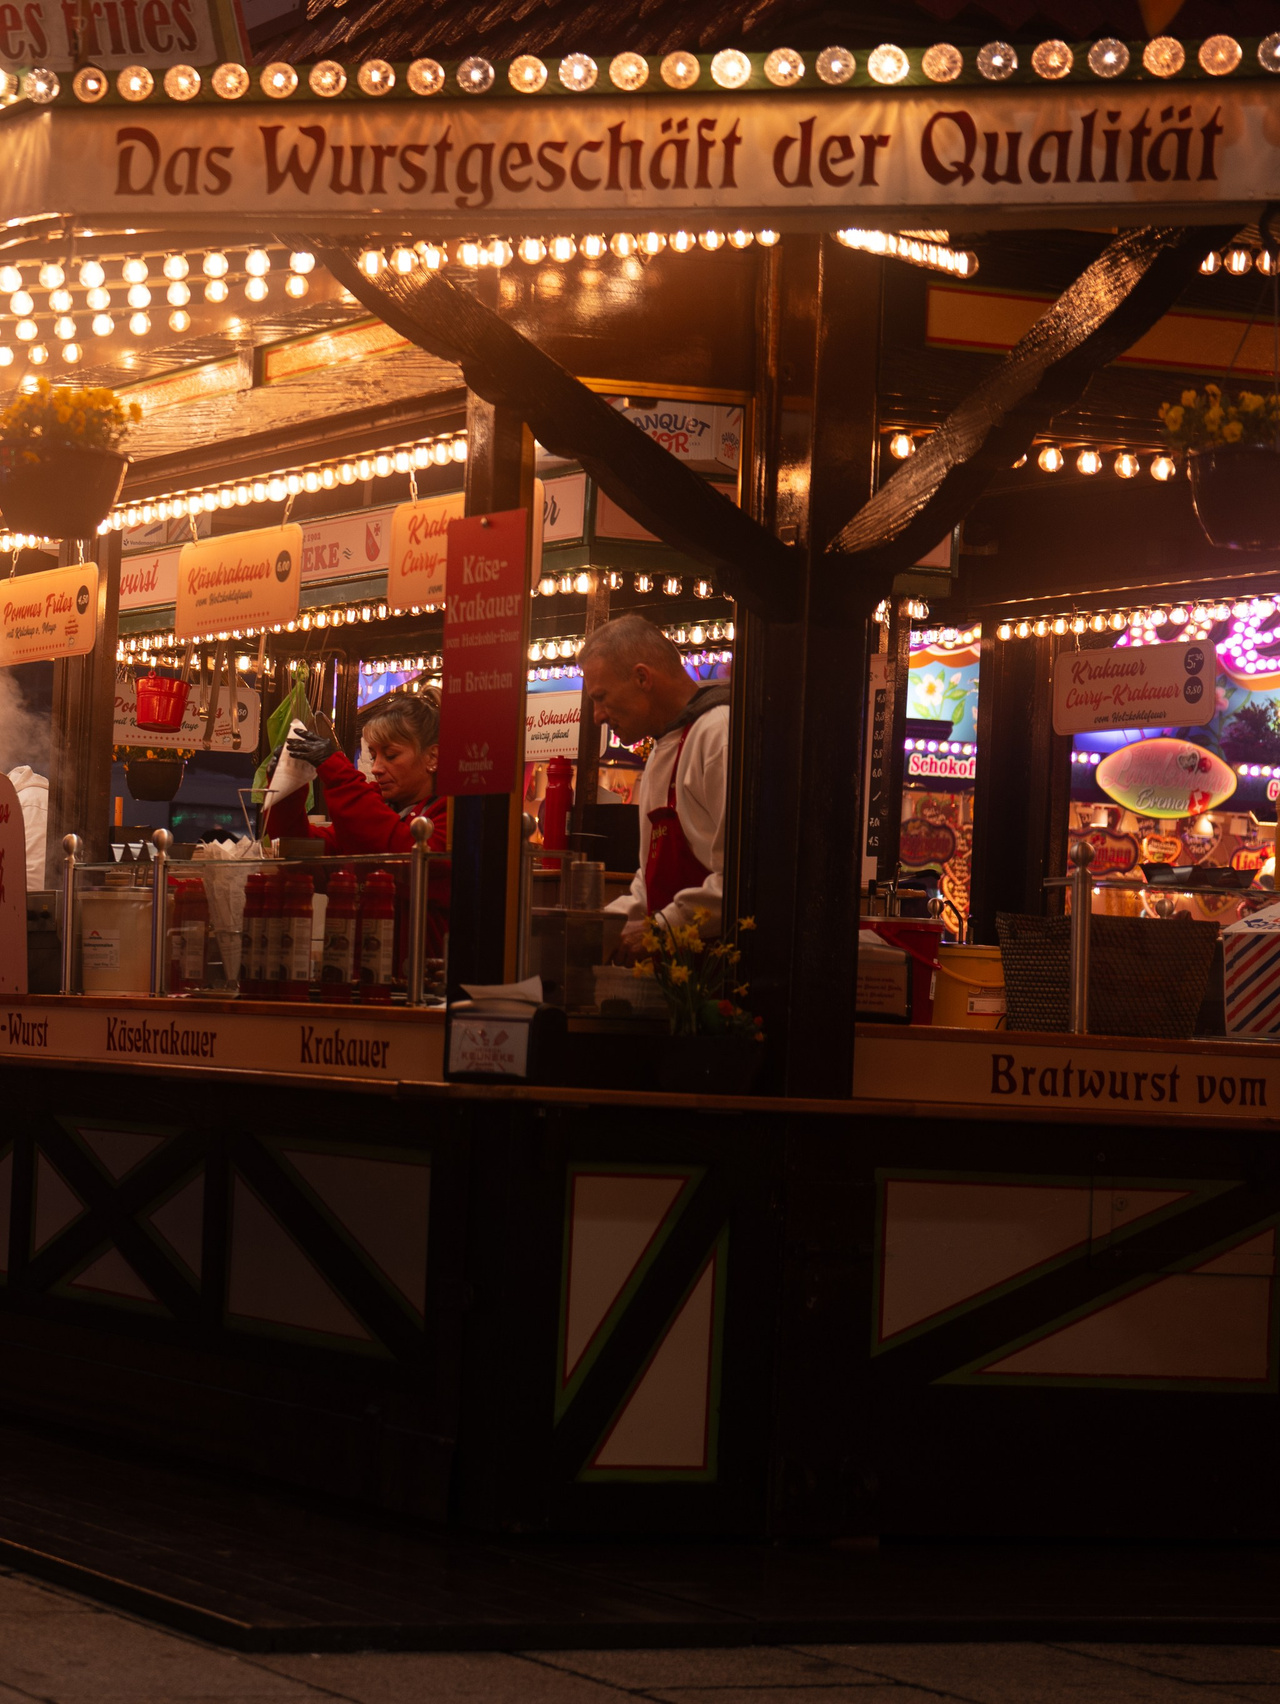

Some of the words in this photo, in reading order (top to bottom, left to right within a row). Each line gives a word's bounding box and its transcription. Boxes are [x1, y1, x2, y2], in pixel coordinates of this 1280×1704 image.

[115, 126, 234, 197] Das
[258, 117, 743, 211] Wurstgeschäft
[772, 115, 891, 188] der
[919, 104, 1224, 188] Qualität
[187, 557, 271, 595] Käsekrakauer
[462, 553, 509, 586] Käse-
[3, 601, 42, 626] Pommes
[45, 592, 73, 618] Frites
[446, 590, 521, 625] Krakauer
[449, 674, 462, 694] im
[465, 670, 513, 692] Brötchen
[1071, 656, 1146, 685] Krakauer
[106, 1016, 218, 1058] Käsekrakauer
[300, 1025, 391, 1069] Krakauer
[990, 1052, 1180, 1103] Bratwurst
[1196, 1072, 1268, 1107] vom
